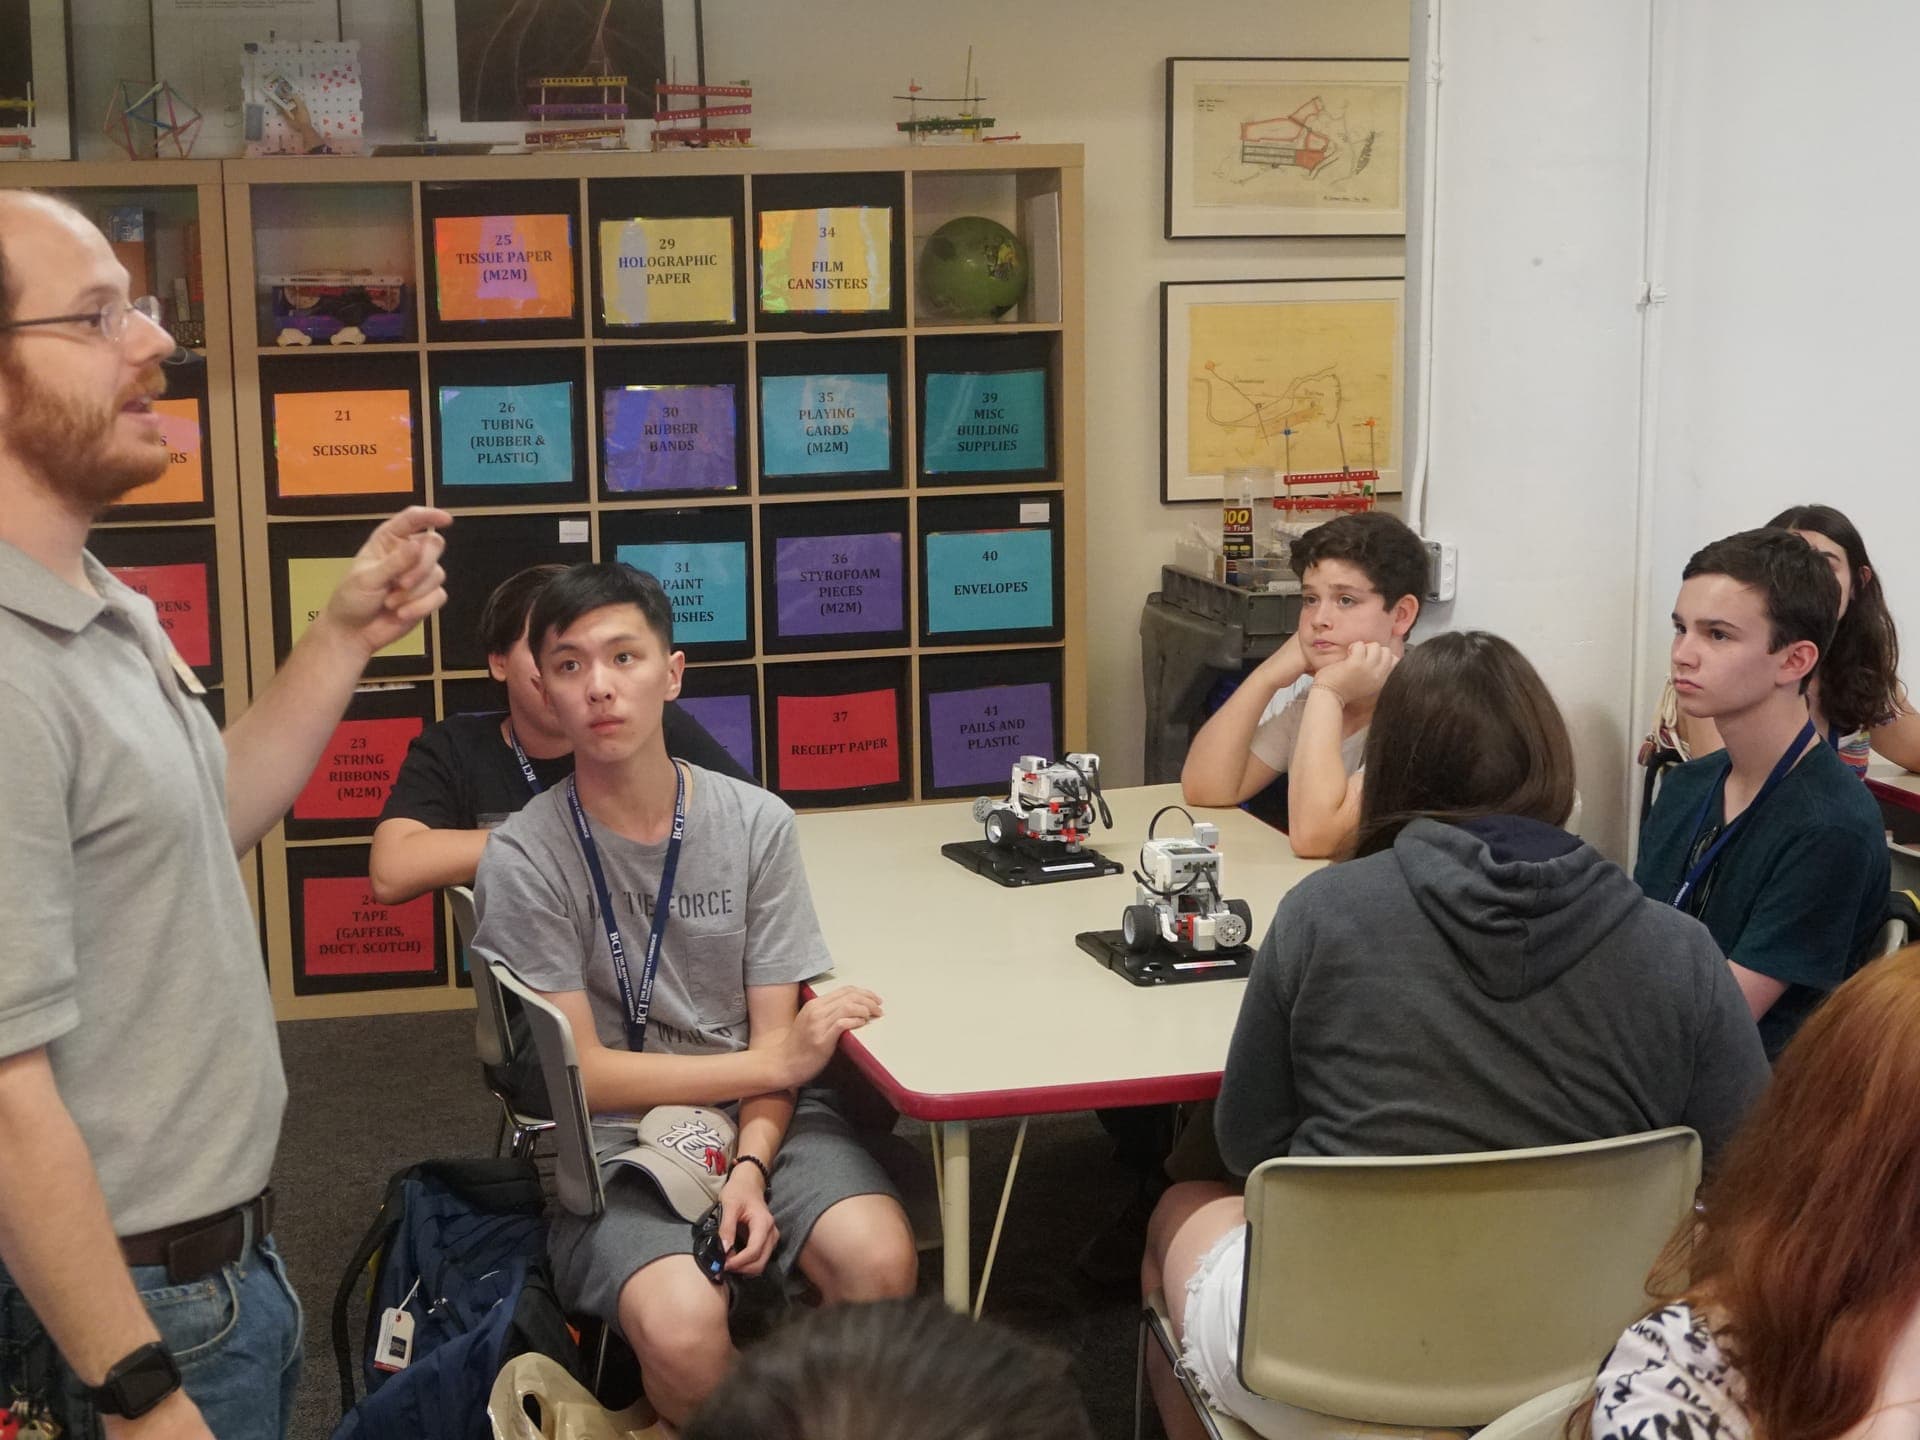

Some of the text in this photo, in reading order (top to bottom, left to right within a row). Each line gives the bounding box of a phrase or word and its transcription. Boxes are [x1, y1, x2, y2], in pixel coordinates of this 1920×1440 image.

[819, 227, 836, 238] 34
[495, 234, 512, 246] 25
[659, 238, 675, 250] 29
[456, 251, 553, 264] TISSUE PAPER
[618, 254, 718, 268] HOLOGRAPHIC
[811, 261, 844, 273] FILM
[483, 269, 528, 282] (M2M)
[646, 272, 691, 285] PAPER
[787, 278, 868, 290] CANSISTERS
[818, 392, 834, 402] 35
[982, 393, 998, 404] 39
[499, 402, 516, 413] 26
[662, 406, 679, 417] 30
[799, 407, 855, 420] PLAYING
[334, 410, 352, 421] 21
[974, 408, 1005, 420] MISC
[481, 418, 534, 431] TUBING
[644, 423, 698, 436] RUBBER
[806, 424, 849, 436] CARDS
[957, 423, 1019, 436] BUILDING
[470, 435, 545, 449] (RUBBER &
[649, 440, 695, 452] BANDS
[807, 441, 849, 455] (M2M)
[957, 440, 1017, 452] SUPPLIES
[312, 443, 377, 457] SCISSORS
[477, 451, 539, 465] PLASTIC)
[832, 553, 848, 564] 36
[982, 551, 998, 561] 40
[675, 562, 690, 573] 31
[800, 568, 881, 582] STYROFOAM
[662, 578, 704, 590] PAINT
[954, 581, 1028, 596] ENVELOPES
[819, 585, 863, 598] PIECES
[820, 601, 862, 616] (M2M)
[671, 611, 714, 623] USHES
[983, 706, 998, 716] 41
[832, 712, 848, 723] 37
[959, 719, 1025, 735] PAILS AND
[351, 738, 366, 749] 23
[791, 738, 888, 756] RECIEPT PAPER
[968, 735, 1020, 750] PLASTIC
[334, 754, 384, 765] STRING
[329, 770, 390, 782] RIBBONS
[337, 787, 382, 799] (M2M)
[672, 817, 684, 840] BCI
[352, 910, 388, 922] TAPE
[362, 940, 421, 953] SCOTCH)
[609, 932, 622, 954] BCI
[636, 1003, 649, 1024] BCI
